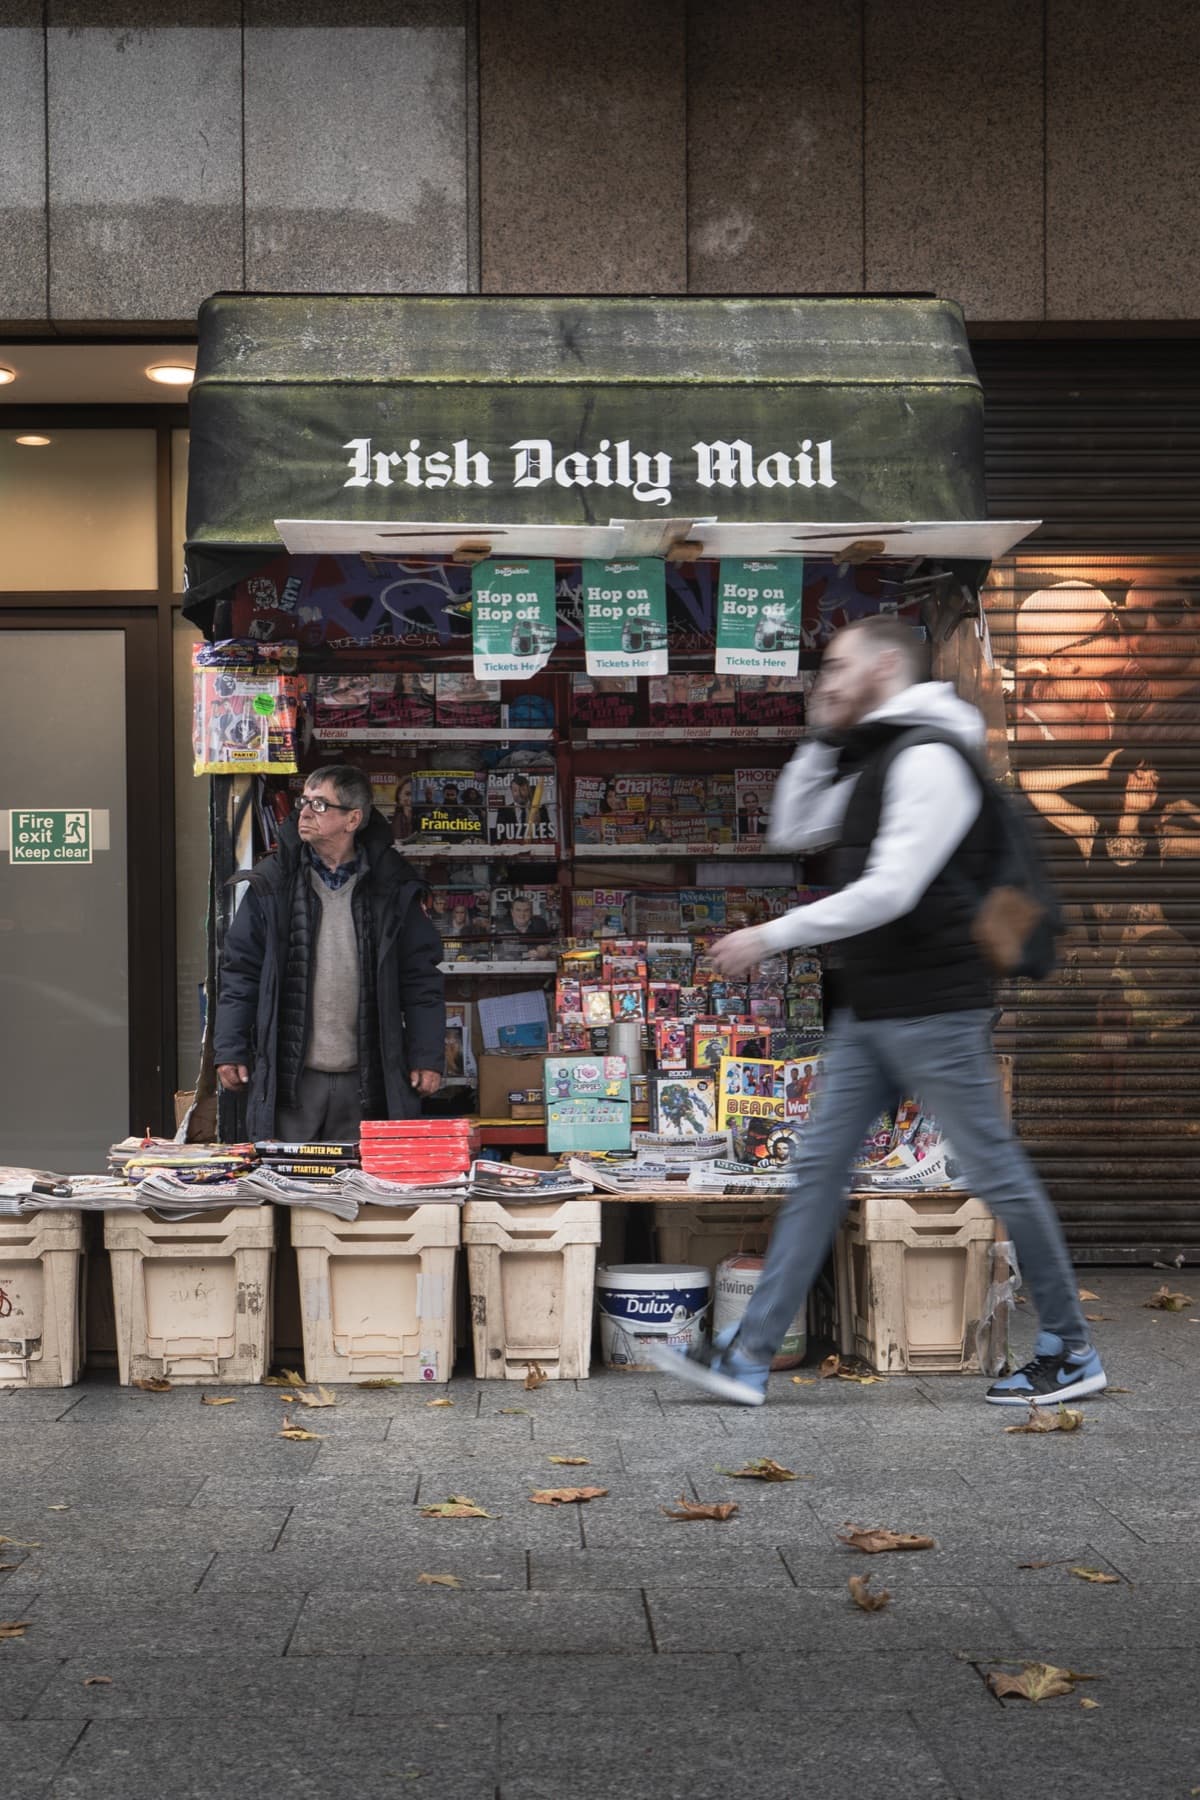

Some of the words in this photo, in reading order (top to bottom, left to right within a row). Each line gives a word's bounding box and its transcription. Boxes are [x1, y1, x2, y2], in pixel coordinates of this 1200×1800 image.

[342, 438, 494, 489] Irish
[510, 439, 672, 506] Daily
[691, 439, 838, 488] Mail
[477, 590, 512, 606] Hop
[516, 592, 538, 603] on
[587, 587, 622, 603] Hop
[626, 588, 648, 600] on
[723, 584, 758, 600] Hop
[763, 588, 785, 599] on
[477, 607, 512, 623] Hop
[516, 606, 541, 620] off
[588, 604, 623, 620] Hop
[627, 603, 651, 617] off
[722, 601, 758, 618] Hop
[762, 603, 786, 616] off
[484, 662, 519, 672] Tickets
[596, 659, 629, 668] Tickets
[726, 656, 760, 667] Tickets
[763, 659, 786, 667] Here
[730, 728, 758, 737] Herald
[19, 814, 54, 828] Fire
[432, 811, 449, 820] The
[420, 817, 482, 831] Franchise
[19, 829, 53, 843] exit
[496, 823, 556, 840] PUZZLES
[15, 846, 50, 860] Keep
[53, 846, 88, 858] clear
[726, 1098, 785, 1118] BEANO
[300, 1146, 326, 1154] STARTER
[326, 1147, 343, 1155] PACK
[293, 1165, 319, 1174] STARTER
[319, 1166, 336, 1174] PACK
[626, 1299, 676, 1314] Dulux
